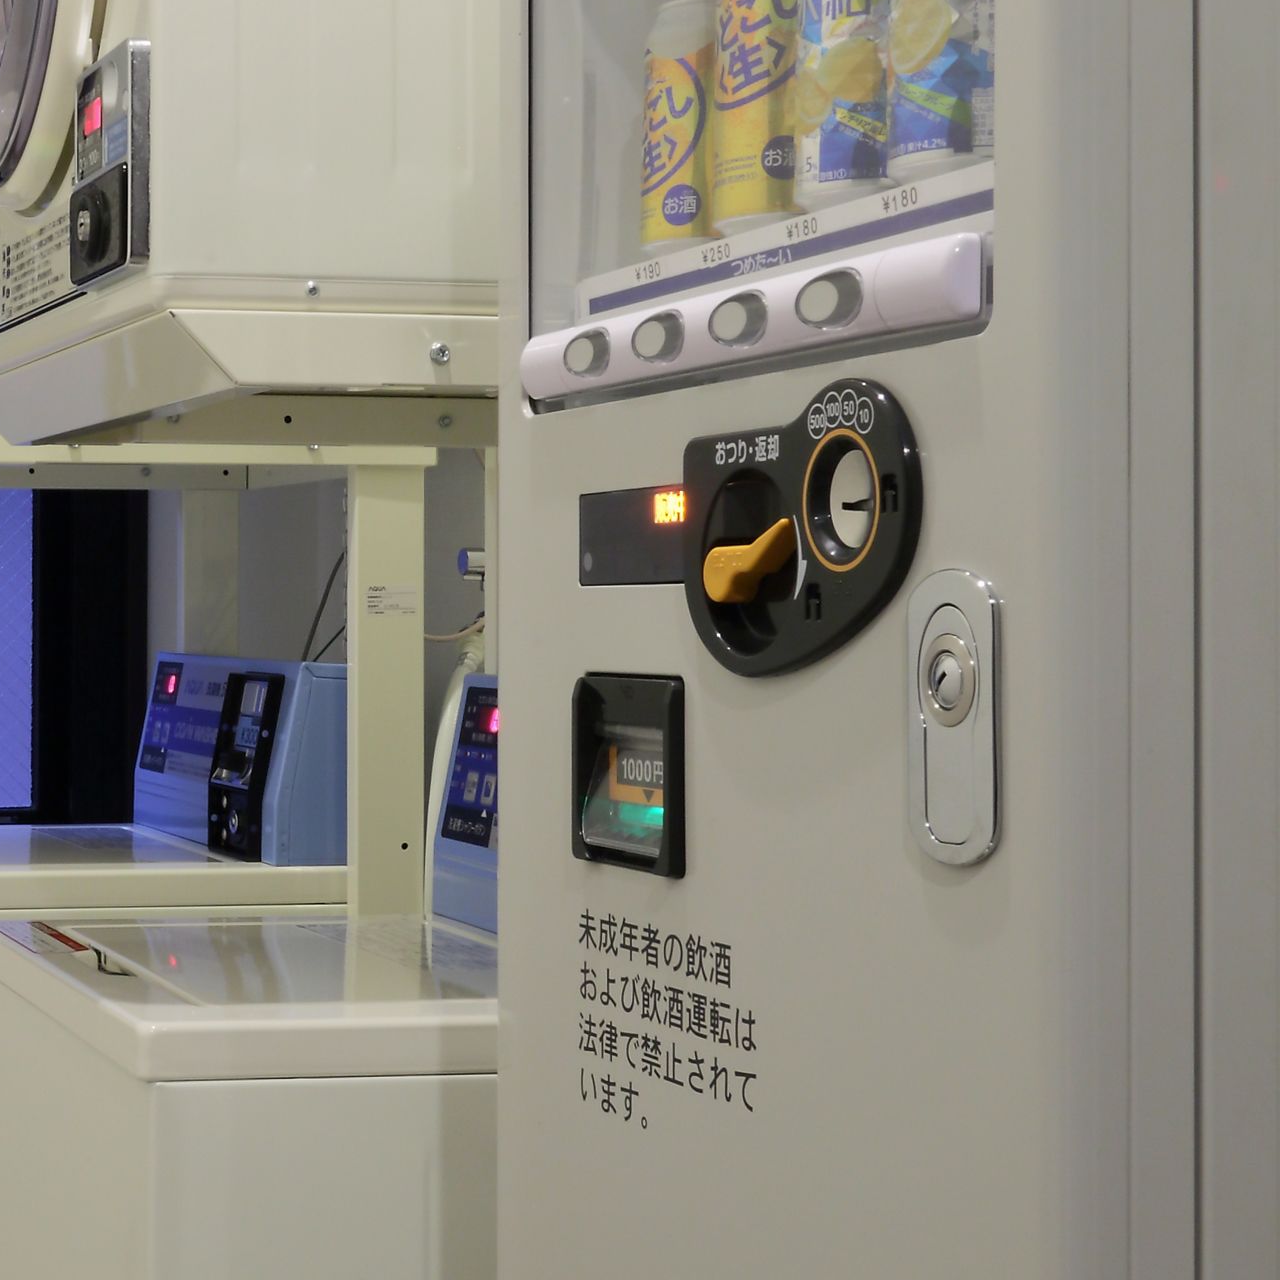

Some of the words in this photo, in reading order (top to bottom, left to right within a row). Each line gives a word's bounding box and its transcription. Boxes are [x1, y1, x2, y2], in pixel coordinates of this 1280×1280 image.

[663, 193, 698, 215] お酒
[882, 187, 918, 213] ¥180
[786, 217, 818, 240] ¥180
[701, 247, 731, 265] ¥250
[634, 261, 662, 282] ¥190
[826, 401, 841, 418] 100
[842, 400, 856, 416] 50
[859, 408, 870, 424] 10
[809, 412, 826, 430] 500
[715, 434, 780, 465] おつり・返却
[621, 757, 664, 784] 1000円
[578, 908, 732, 989] 未成年者の飲酒
[579, 960, 757, 1052] および飲酒運転は
[578, 1012, 757, 1113] 法律で禁止されて
[580, 1067, 649, 1130] います。
